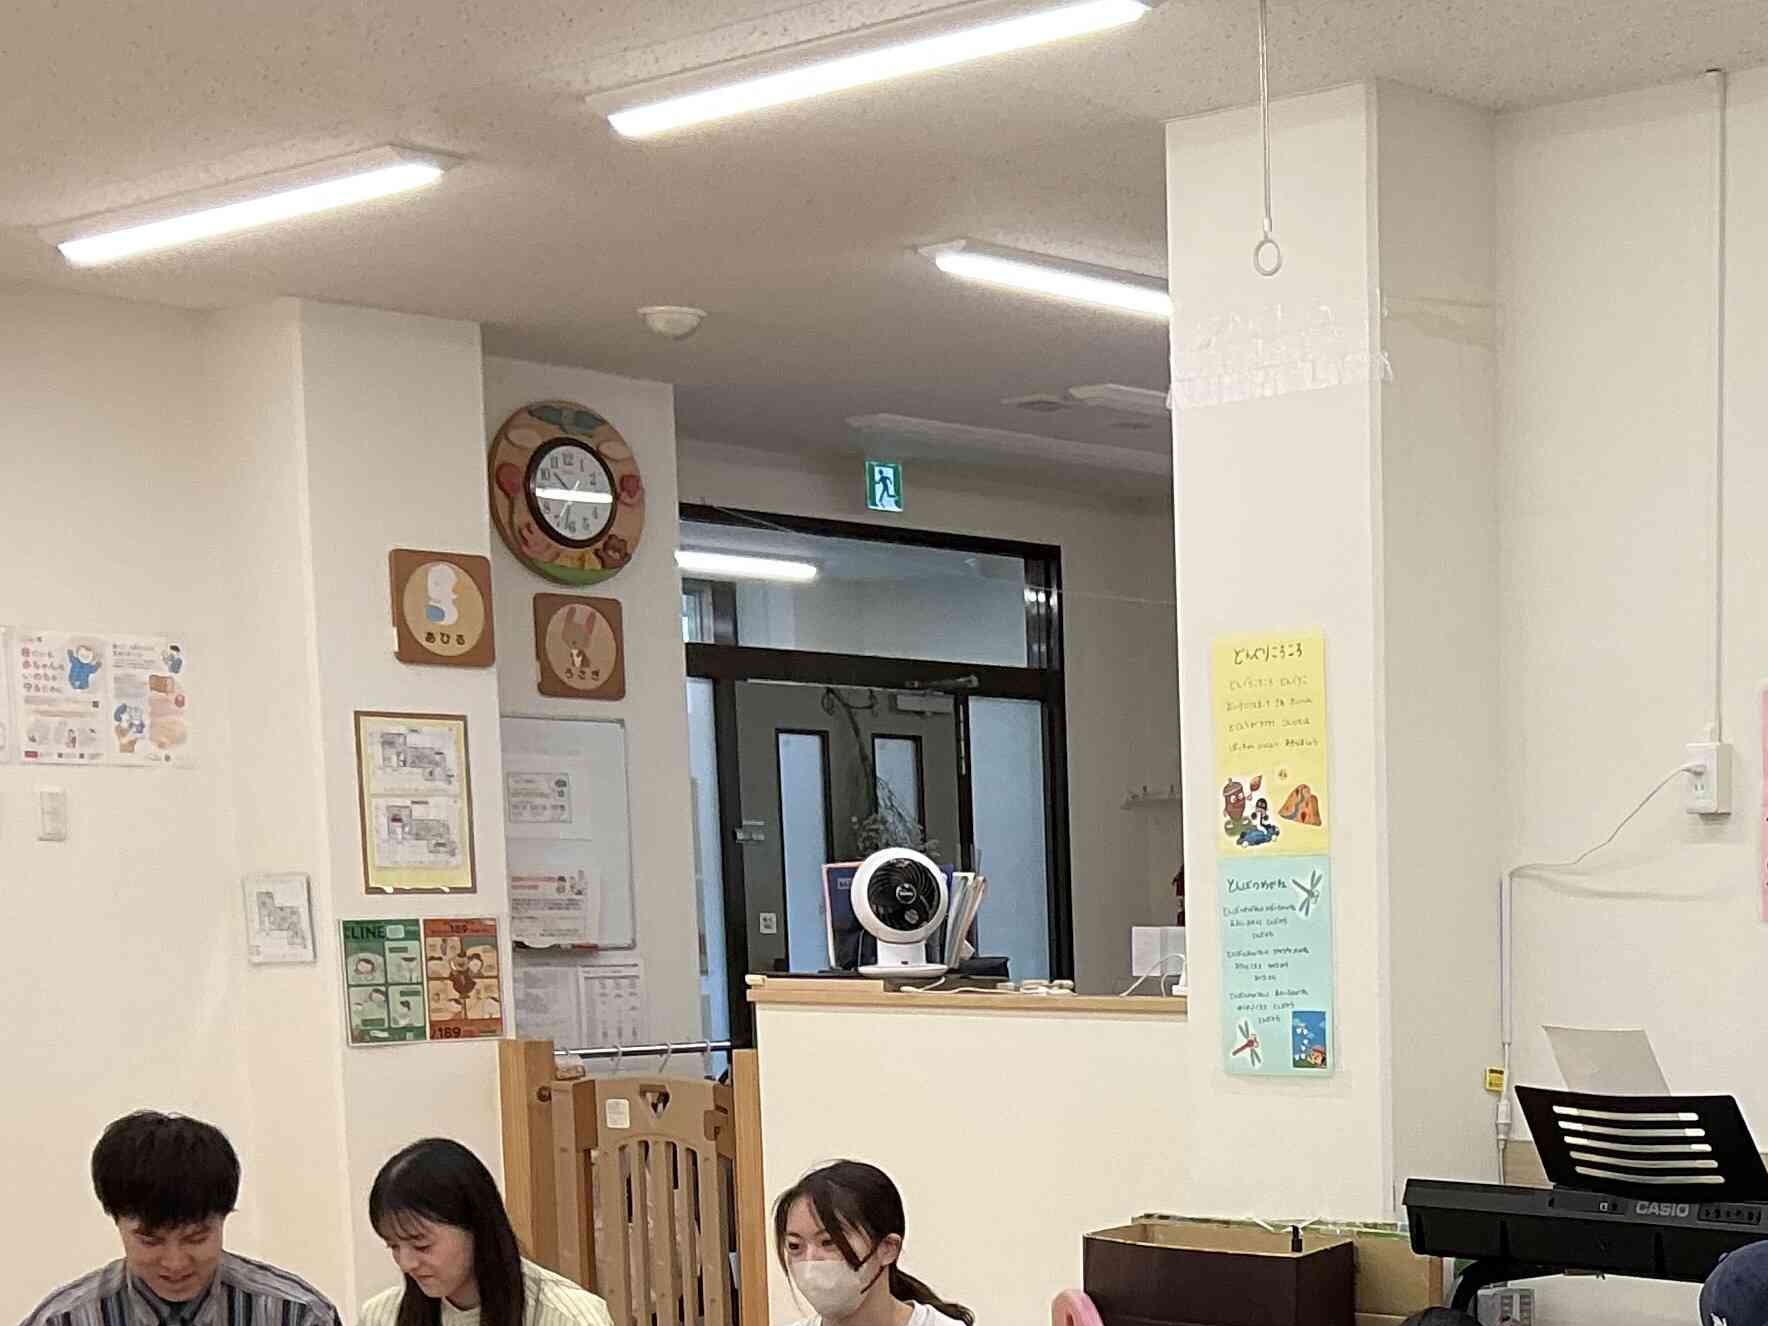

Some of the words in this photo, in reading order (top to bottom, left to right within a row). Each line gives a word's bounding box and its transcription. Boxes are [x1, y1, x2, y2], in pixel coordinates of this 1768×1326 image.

[425, 631, 466, 646] あひる
[352, 926, 385, 940] LINE
[438, 1026, 461, 1039] 189
[1636, 1200, 1690, 1217] CASIO
